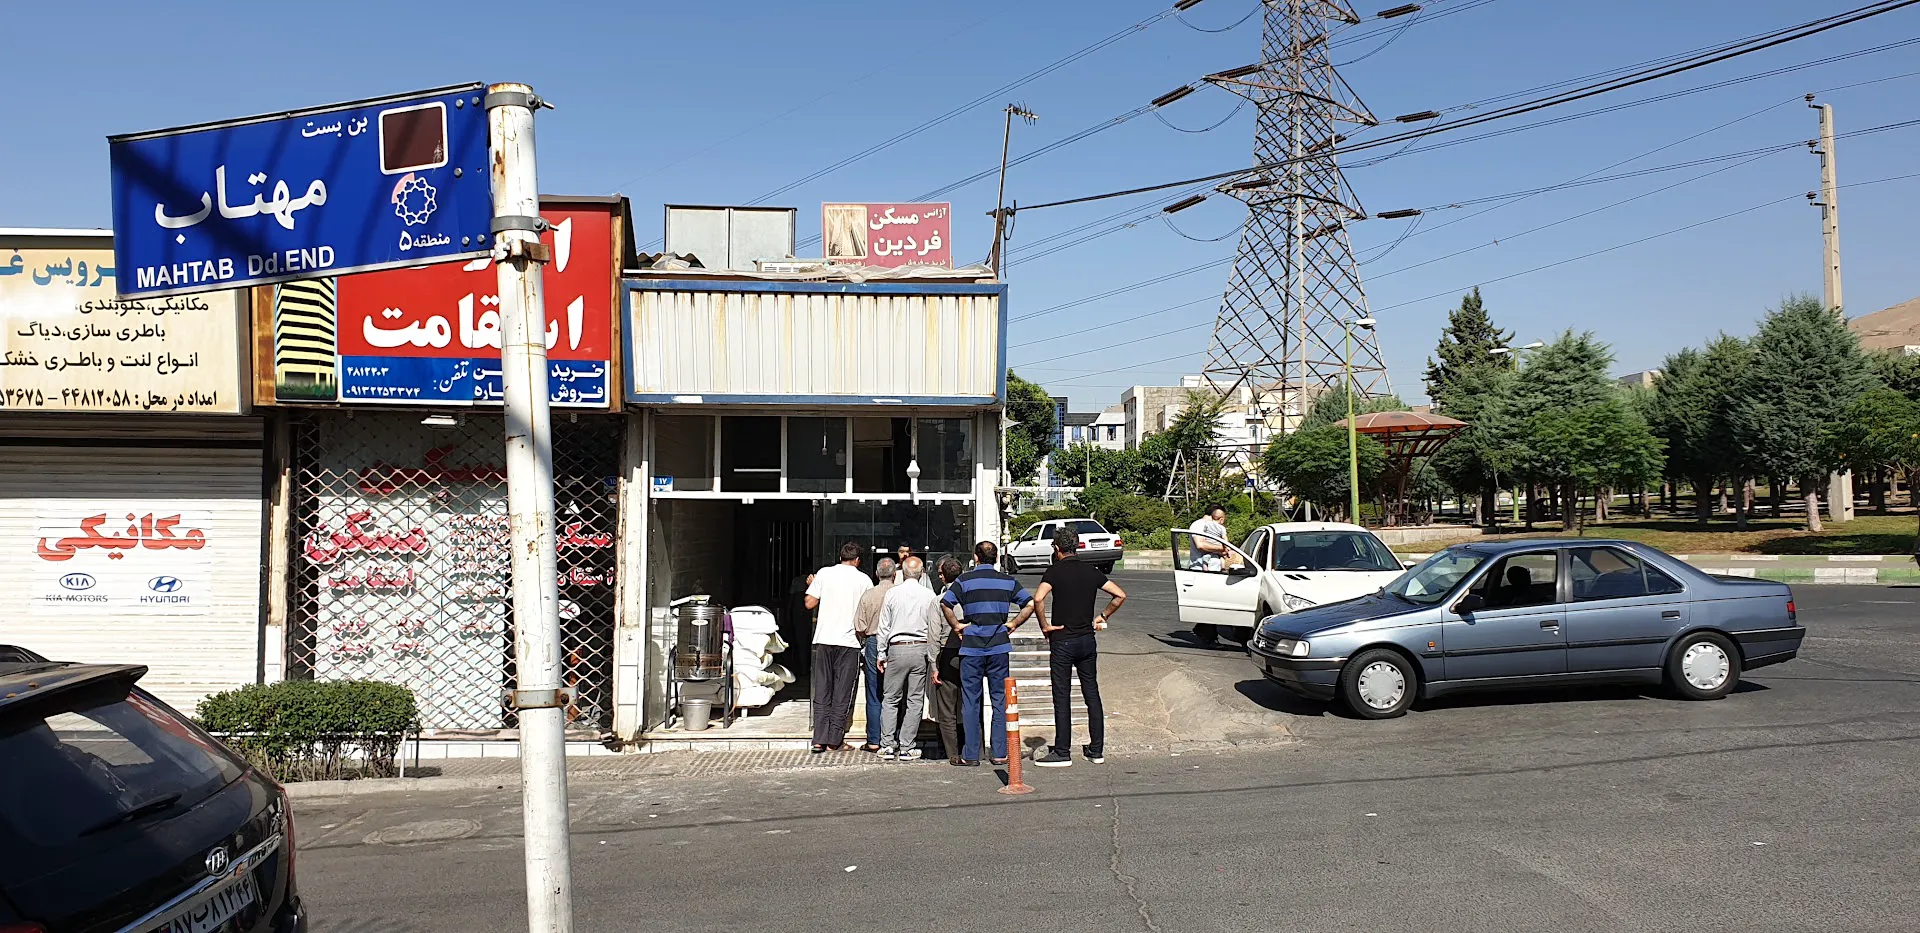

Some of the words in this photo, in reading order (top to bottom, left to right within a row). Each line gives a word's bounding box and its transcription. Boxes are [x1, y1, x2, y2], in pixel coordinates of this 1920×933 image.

[301, 119, 342, 139] بست
[347, 115, 369, 135] بن
[154, 164, 328, 245] مهتاب
[923, 207, 947, 219] آژانس
[869, 207, 919, 231] مسکن
[398, 230, 413, 251] ۵
[412, 231, 451, 248] منطقه
[873, 229, 942, 256] فردین
[32, 255, 116, 287] رویس
[136, 257, 235, 289] MAHTAB
[247, 245, 335, 276] Dd.END
[363, 292, 585, 351] اقامت
[116, 323, 166, 342] باطری
[44, 351, 102, 372] باطری
[107, 357, 115, 372] و
[120, 352, 151, 368] لنت
[157, 352, 198, 375] انواع
[551, 363, 605, 382] خرید
[61, 388, 131, 407] ۴۴۸۱۲۰۵۸
[187, 390, 217, 407] امداد
[473, 381, 505, 401] اره
[551, 385, 604, 403] فروش
[172, 395, 184, 411] در
[659, 477, 667, 485] ۱۷
[36, 512, 206, 562] مکانیکی
[65, 577, 90, 587] KIA
[556, 566, 615, 587] استقام
[45, 594, 63, 603] KIA
[65, 594, 109, 603] MOTORS
[140, 595, 190, 604] HYUNDAI
